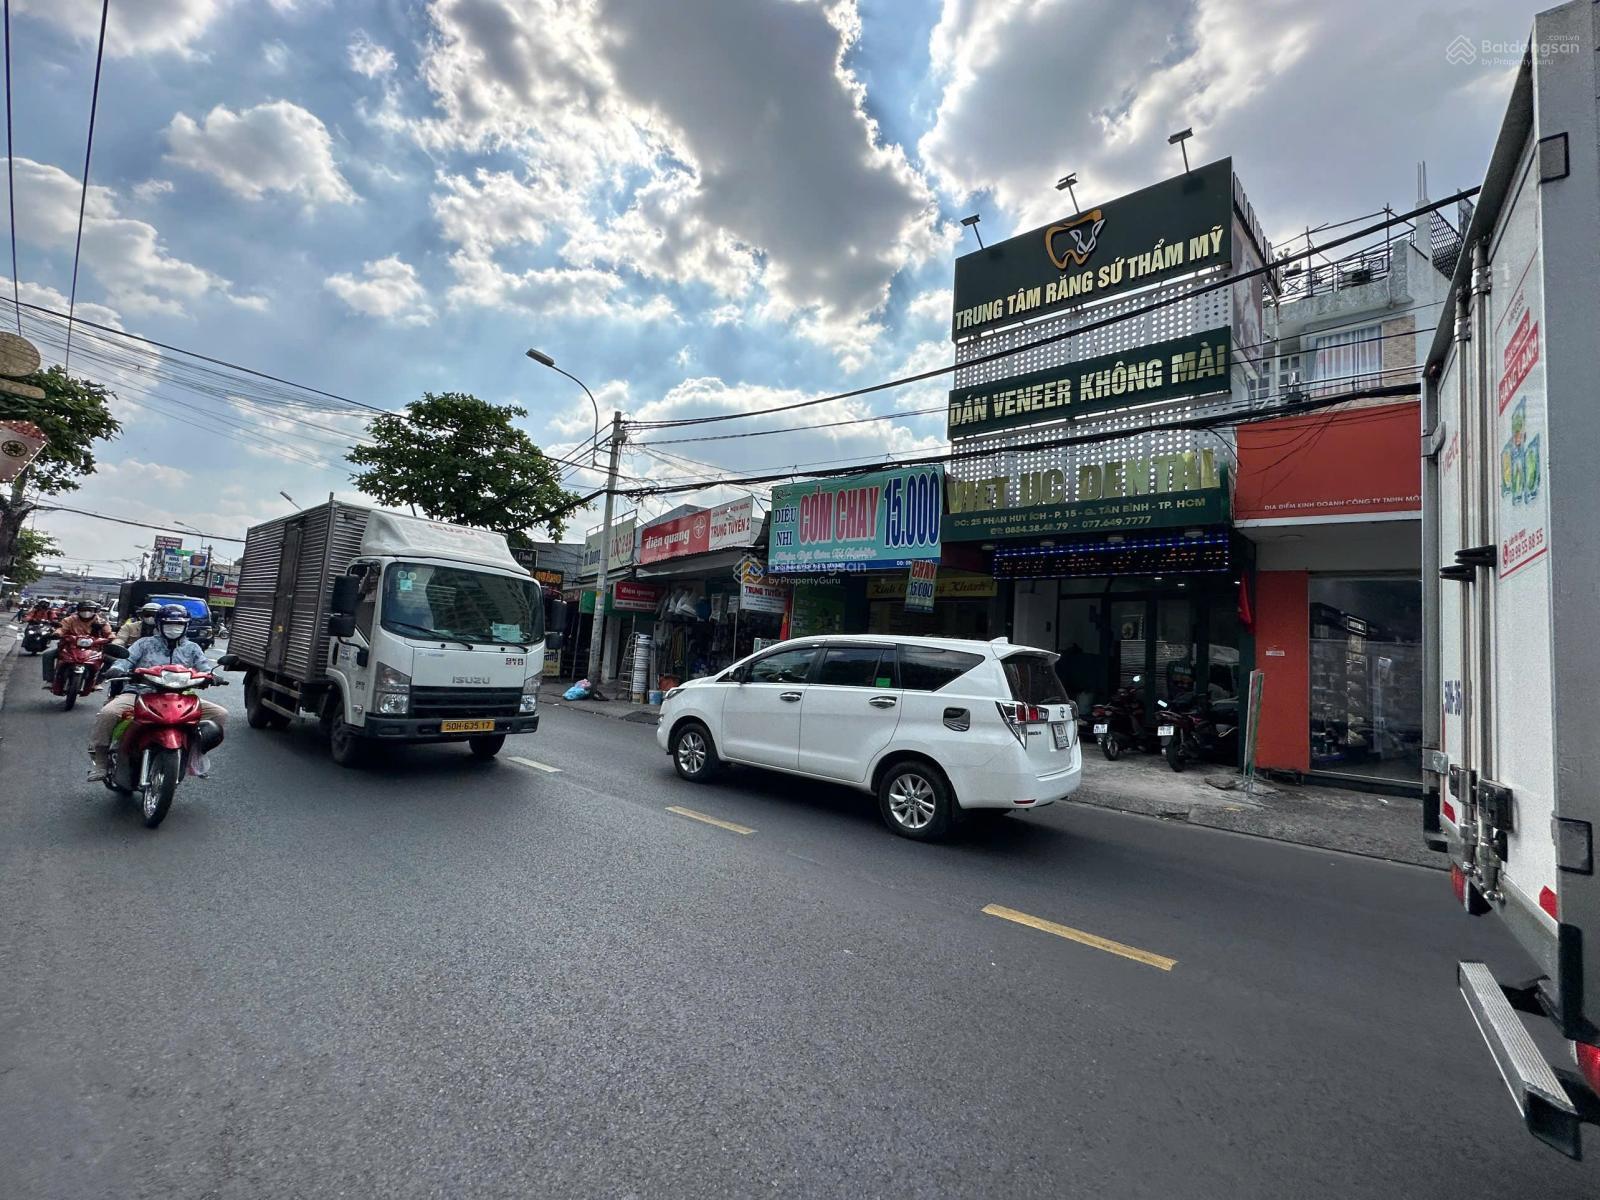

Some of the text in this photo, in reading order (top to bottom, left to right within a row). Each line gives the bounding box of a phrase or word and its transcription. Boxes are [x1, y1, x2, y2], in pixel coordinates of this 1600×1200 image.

[955, 225, 1224, 331] TRUNG TÂM RĂNG SỨ THẨM MỸ
[949, 342, 1226, 427] DÁN VENEER KHÔNG MÀI
[1079, 448, 1221, 501] DENTAL
[775, 503, 797, 527] DIỆU
[800, 471, 940, 547] CƠM CHAY 15.000
[983, 516, 1007, 525] PHAN
[1009, 514, 1027, 523] HUY
[1065, 510, 1077, 518] 15
[1100, 505, 1120, 515] TÂN
[1123, 502, 1149, 512] BÌNH
[1158, 501, 1173, 510] TP.
[1177, 498, 1206, 508] HCM
[1317, 500, 1344, 508] DOANH
[711, 516, 750, 538] TRUNG TUYẾN 2
[664, 529, 690, 549] quang
[776, 531, 792, 546] NHI
[912, 561, 936, 580] CHAY
[910, 581, 933, 598] 15.000
[452, 676, 491, 685] ISUZU
